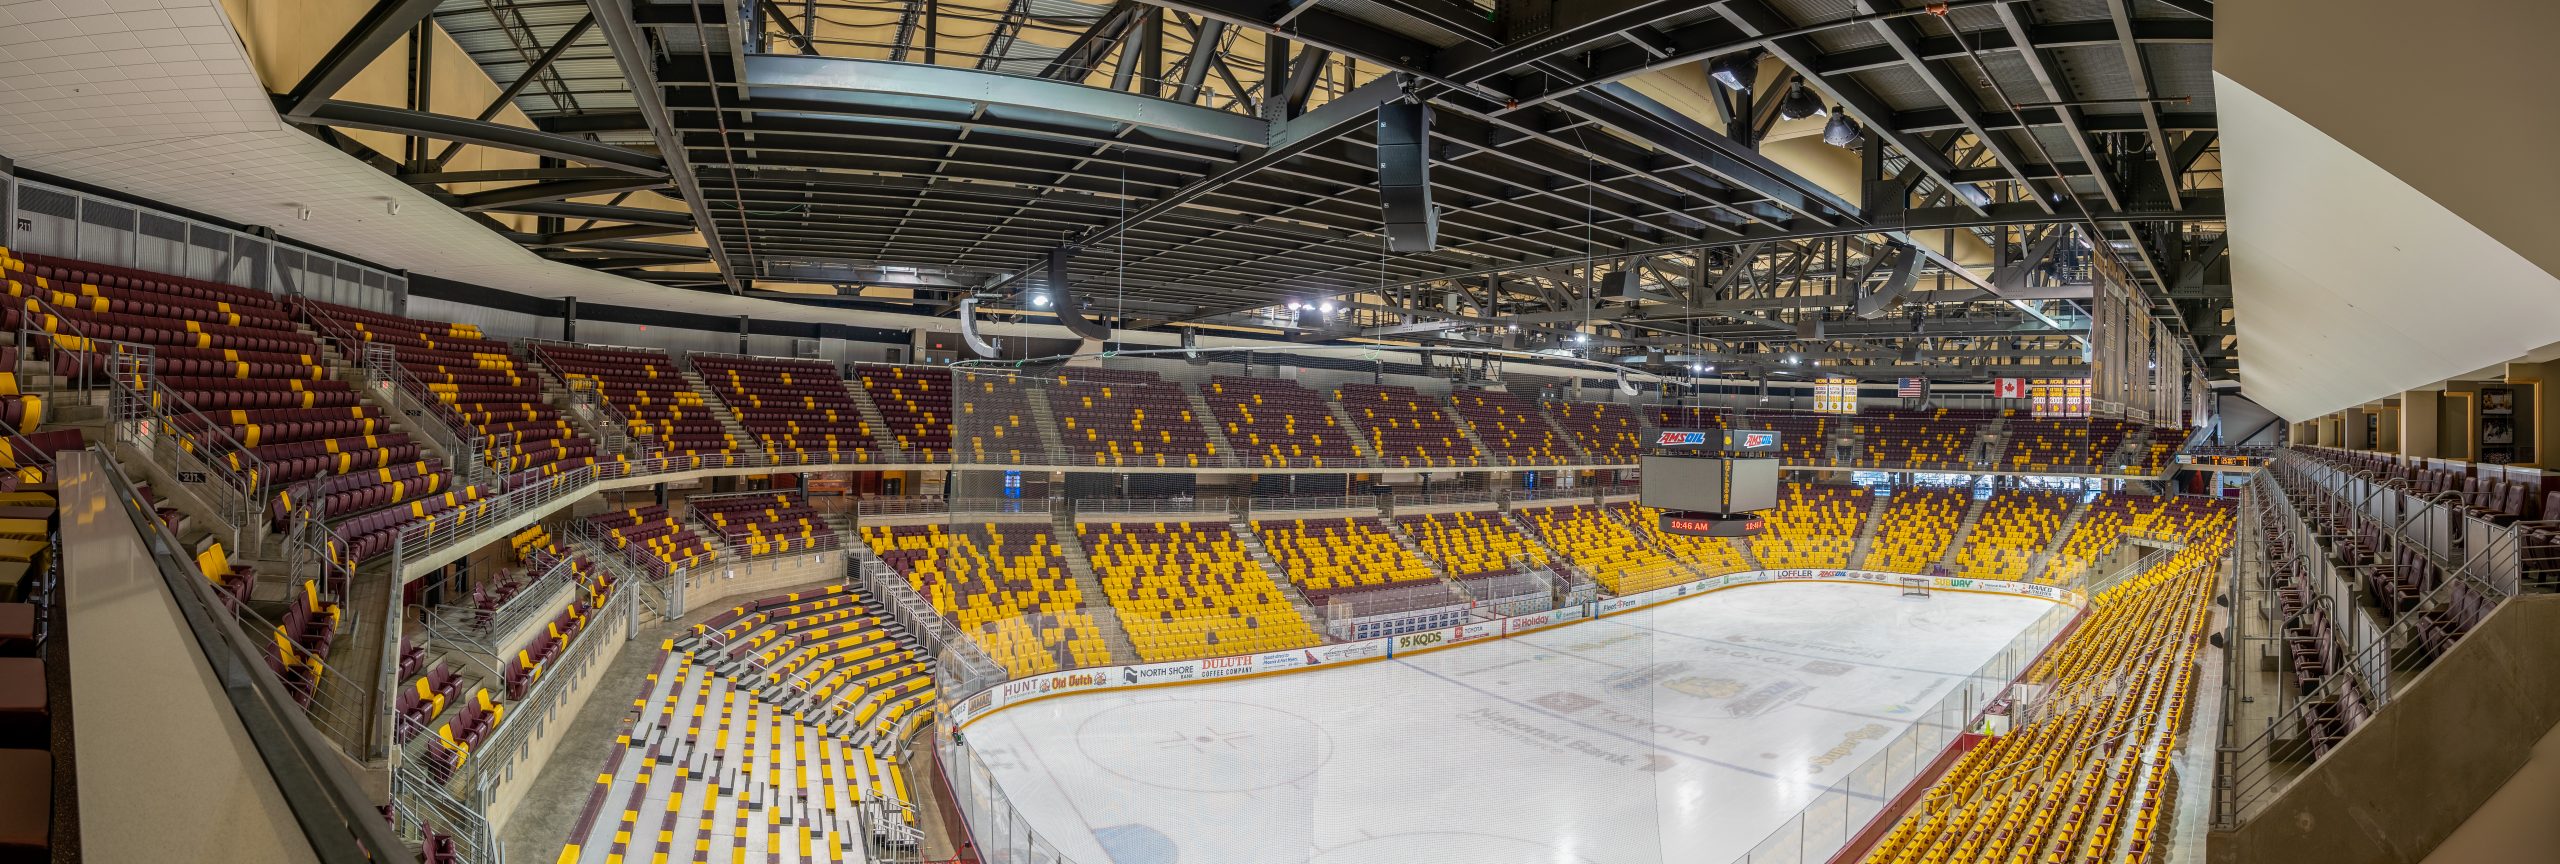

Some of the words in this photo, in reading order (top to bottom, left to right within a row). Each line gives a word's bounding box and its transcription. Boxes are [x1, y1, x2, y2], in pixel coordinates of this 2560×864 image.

[19, 221, 31, 231] 211
[2033, 396, 2046, 404] 2001
[1656, 431, 1706, 445] AMSOIL
[1744, 434, 1773, 448] AMSOIL
[1671, 520, 1693, 529] 10:46
[1694, 522, 1709, 531] AM
[1818, 570, 1848, 578] AMSOIL
[1935, 578, 1972, 588] SUBWAY
[1603, 603, 1617, 611] Fleet
[1622, 600, 1636, 608] Farm
[1521, 615, 1549, 627] Holiday
[1464, 626, 1483, 634] TOYOTA
[1400, 636, 1411, 649] 95
[1412, 631, 1442, 646] KQDS
[1202, 655, 1253, 670] DULUTH
[1140, 668, 1167, 678] NORTH
[1168, 665, 1194, 675] SHORE
[1202, 669, 1224, 677] COFFEE
[1225, 666, 1253, 676] COMPANY
[1004, 678, 1038, 697] HUNT
[1052, 676, 1066, 690] Old
[1068, 674, 1092, 687] Dutch
[1471, 707, 1568, 743] National
[1565, 738, 1638, 767] Bank
